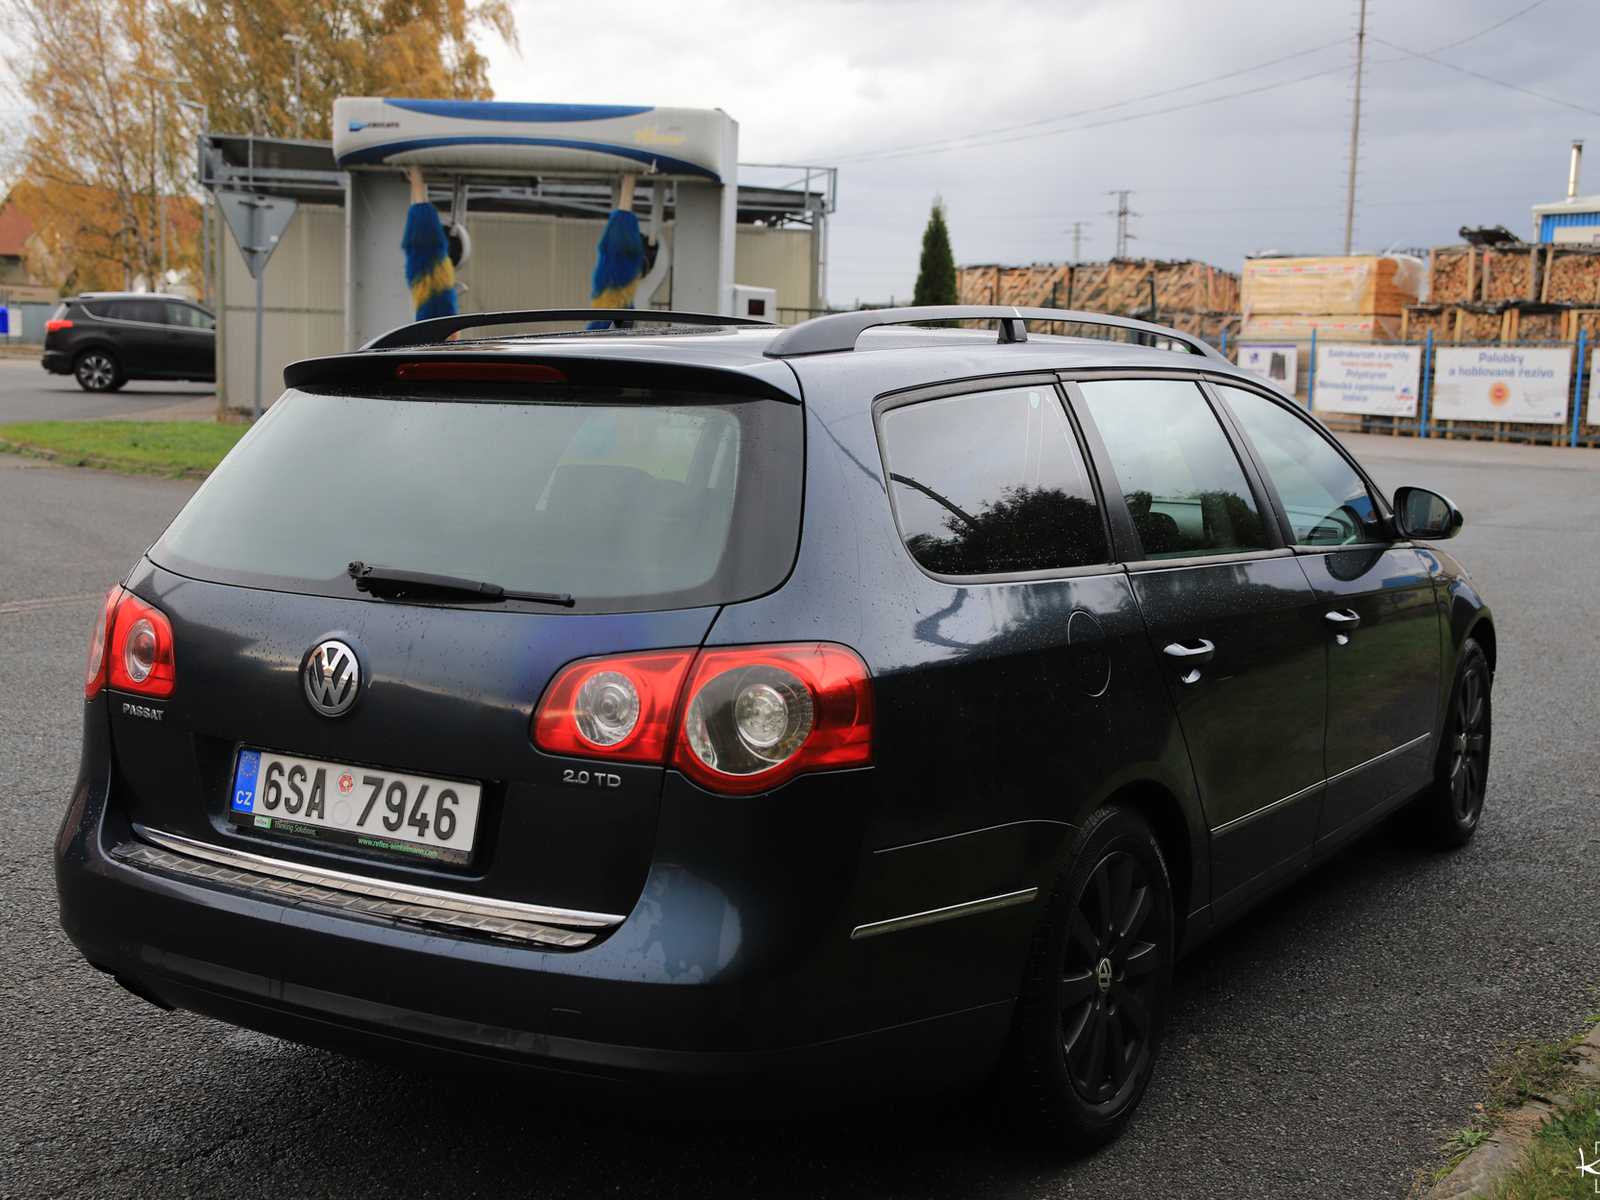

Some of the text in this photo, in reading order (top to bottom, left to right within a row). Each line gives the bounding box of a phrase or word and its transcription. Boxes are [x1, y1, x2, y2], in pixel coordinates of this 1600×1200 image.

[1478, 352, 1524, 365] Palubky
[122, 702, 164, 721] PASSAT
[563, 769, 622, 788] 2.0 TD
[236, 790, 253, 806] CZ
[262, 761, 459, 841] 6SA 7946
[274, 820, 294, 833] Thinking
[358, 838, 438, 857] www.reflex-winkelmann.com
